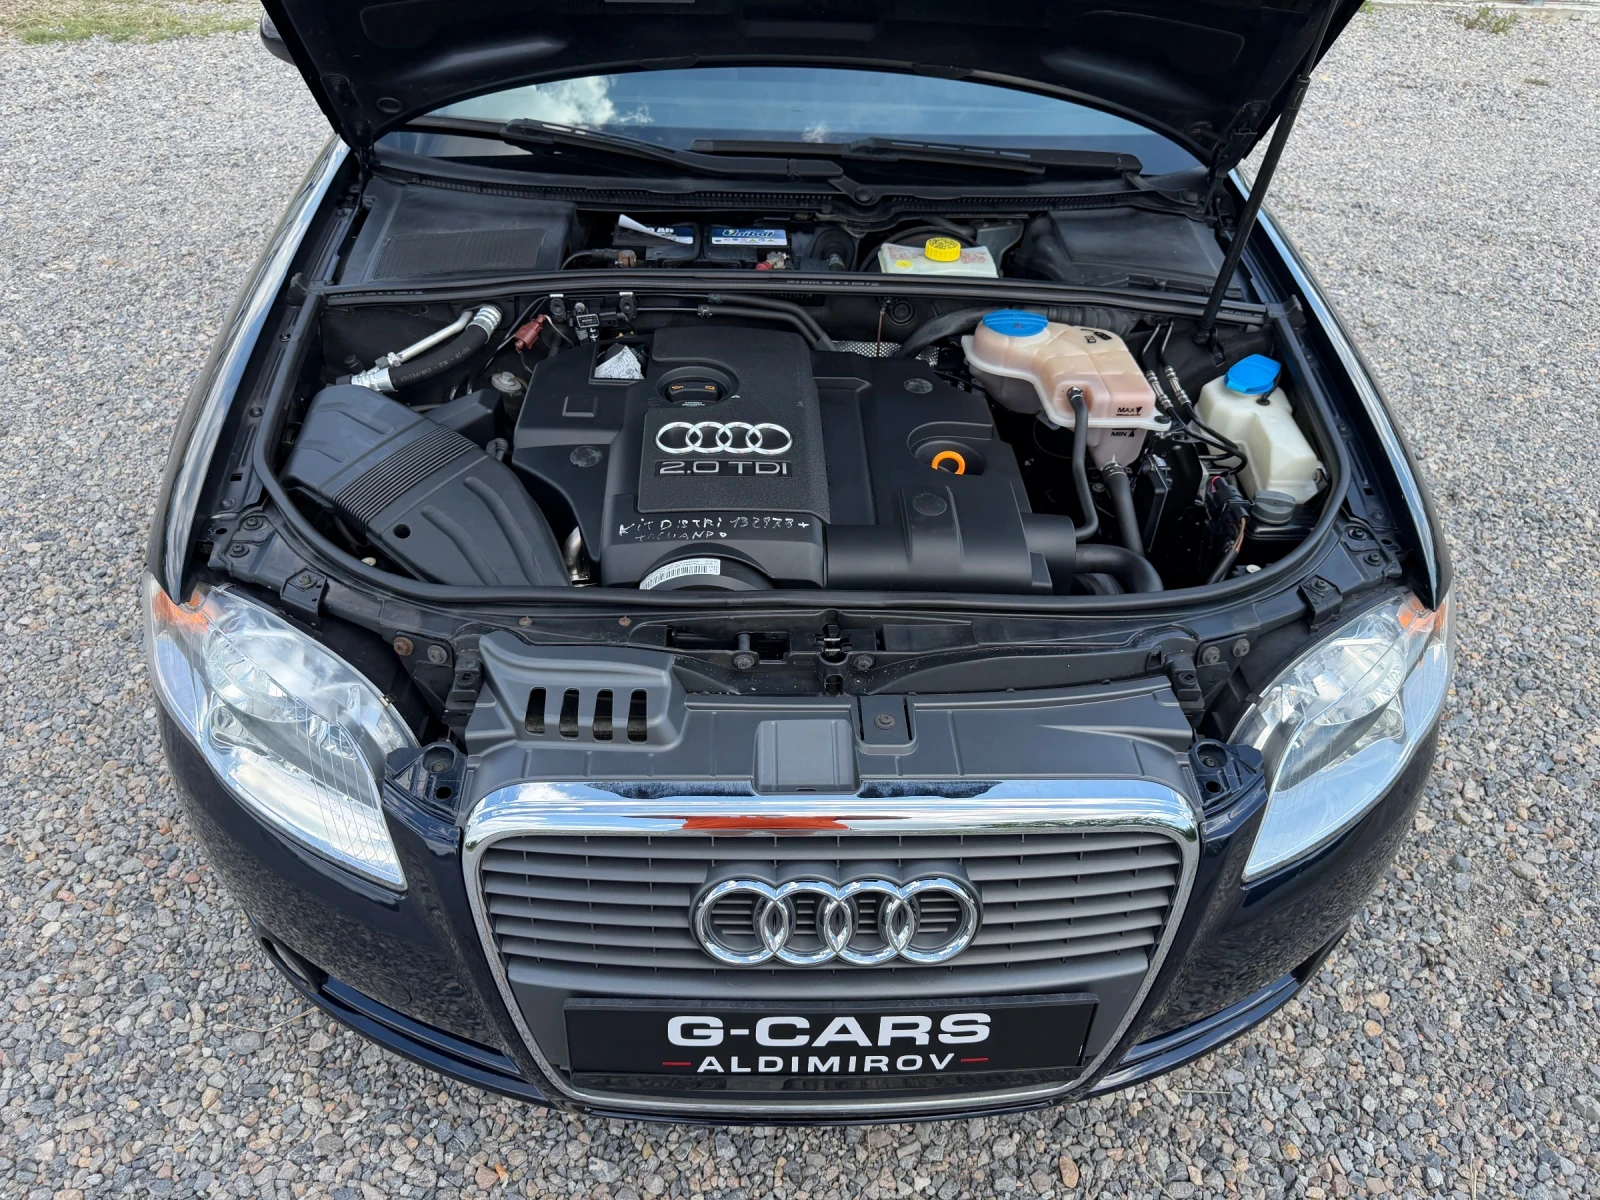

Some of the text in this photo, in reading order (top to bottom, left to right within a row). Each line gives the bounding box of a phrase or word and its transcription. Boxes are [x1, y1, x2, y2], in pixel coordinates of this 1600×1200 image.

[659, 461, 788, 475] 2.0 TDI
[667, 1012, 991, 1047] G-CARS
[696, 1053, 955, 1073] ALDIMIROV
